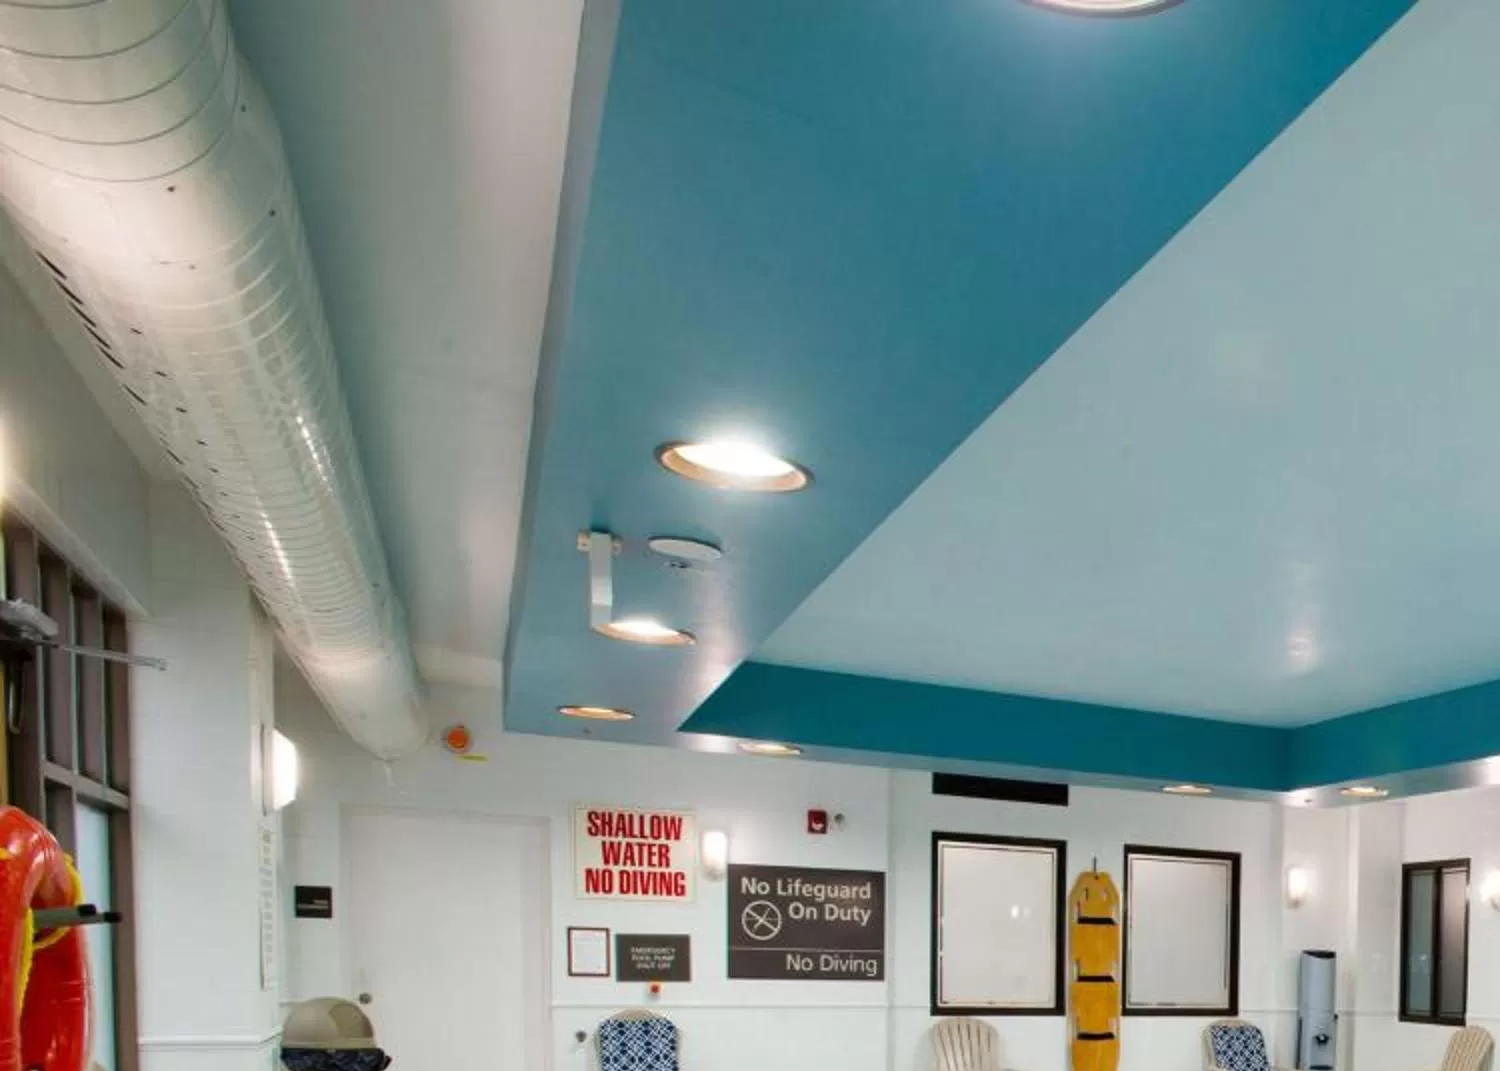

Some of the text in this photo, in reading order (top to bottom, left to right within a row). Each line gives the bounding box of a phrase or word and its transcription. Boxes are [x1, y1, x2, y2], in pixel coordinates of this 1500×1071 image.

[587, 810, 682, 841] SHALLOW
[601, 841, 671, 868] WATER
[584, 868, 687, 897] NO DIVING
[740, 876, 872, 900] No Lifeguard
[788, 903, 872, 927] On Duty
[785, 953, 878, 977] No Diving
